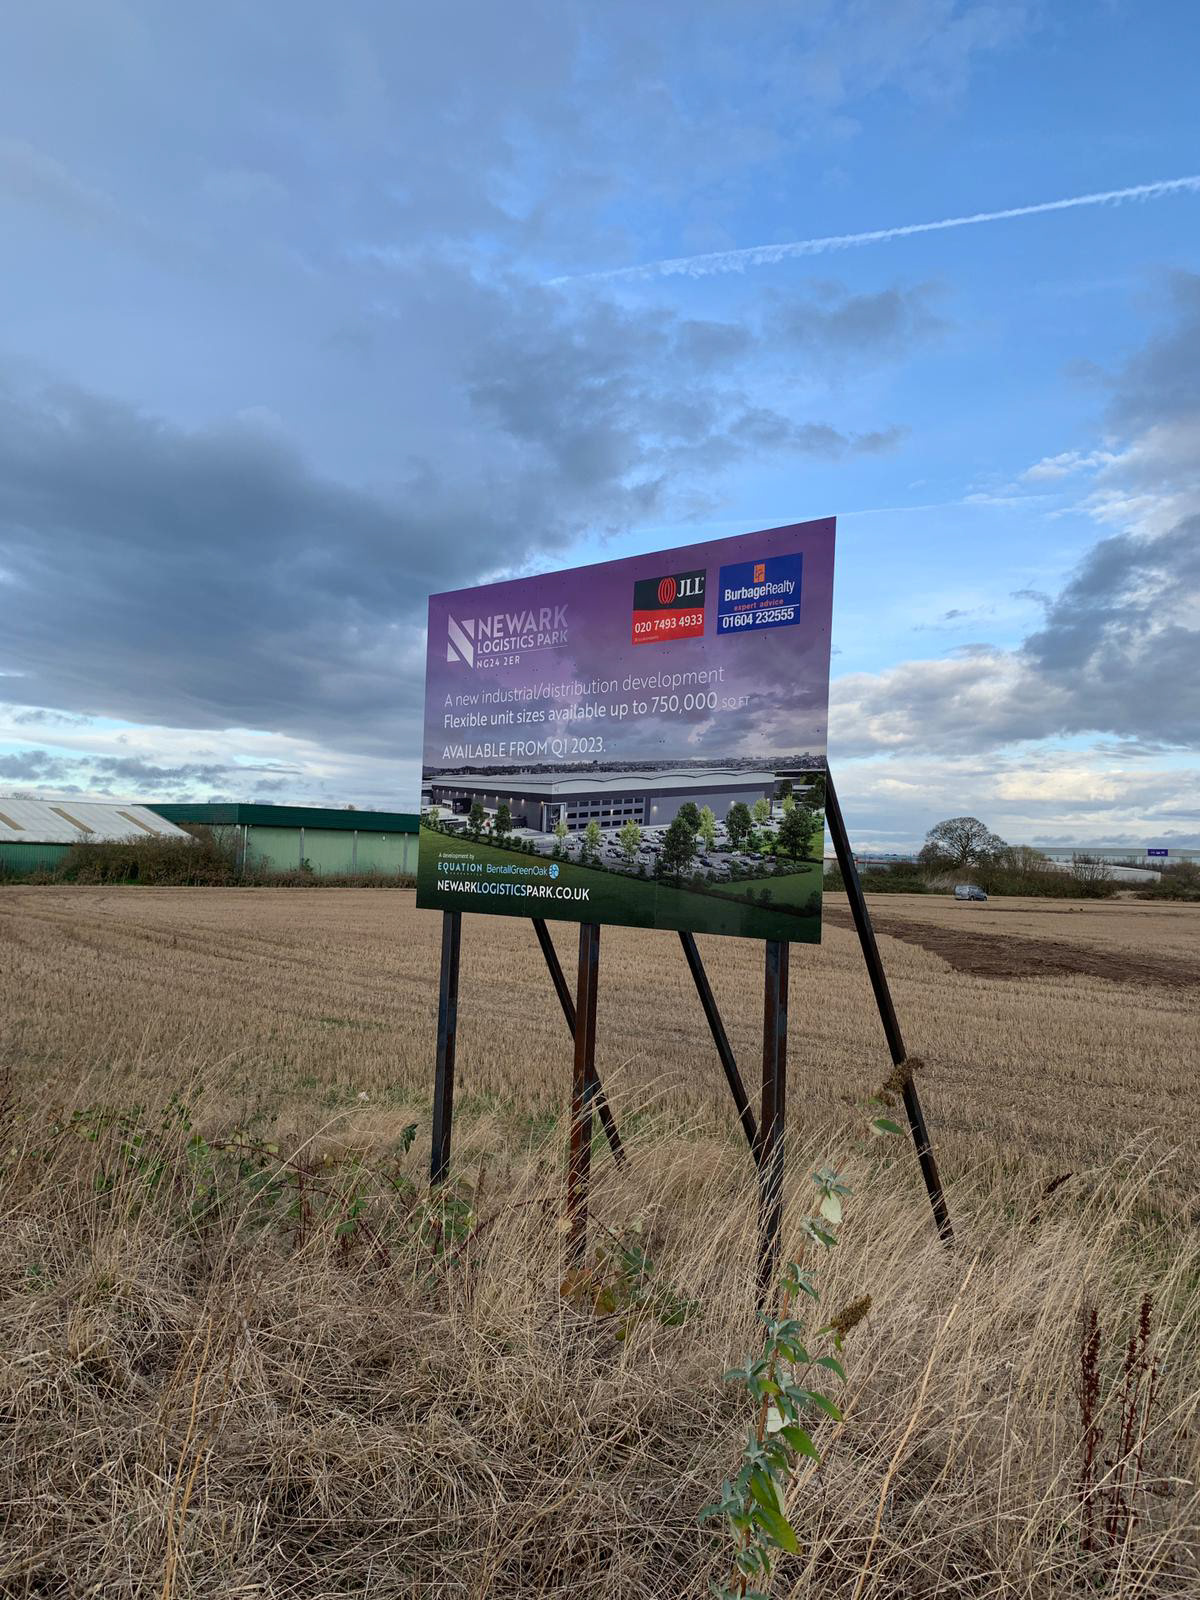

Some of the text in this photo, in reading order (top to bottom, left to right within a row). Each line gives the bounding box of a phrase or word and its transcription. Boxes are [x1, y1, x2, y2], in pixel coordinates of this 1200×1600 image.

[724, 579, 795, 601] BurbageRealty
[733, 598, 784, 612] expert advice
[478, 604, 569, 640] NEWARK
[635, 613, 703, 633] 020 7493 4933
[722, 607, 794, 629] 01604 232555
[477, 629, 568, 654] LOGISTICS PARK
[476, 655, 520, 669] NG24 2ER
[444, 667, 725, 707] A new industrial/distribution development
[444, 691, 750, 729] Flexible unit sizes available up to 750,000 SQ FT
[442, 737, 607, 760] AVAILABLE FROM Q1 2023.
[437, 862, 548, 876] EQUATION BentallGreenOak
[437, 879, 590, 901] NEWARKLOGISTICSPARK.CO.UK
